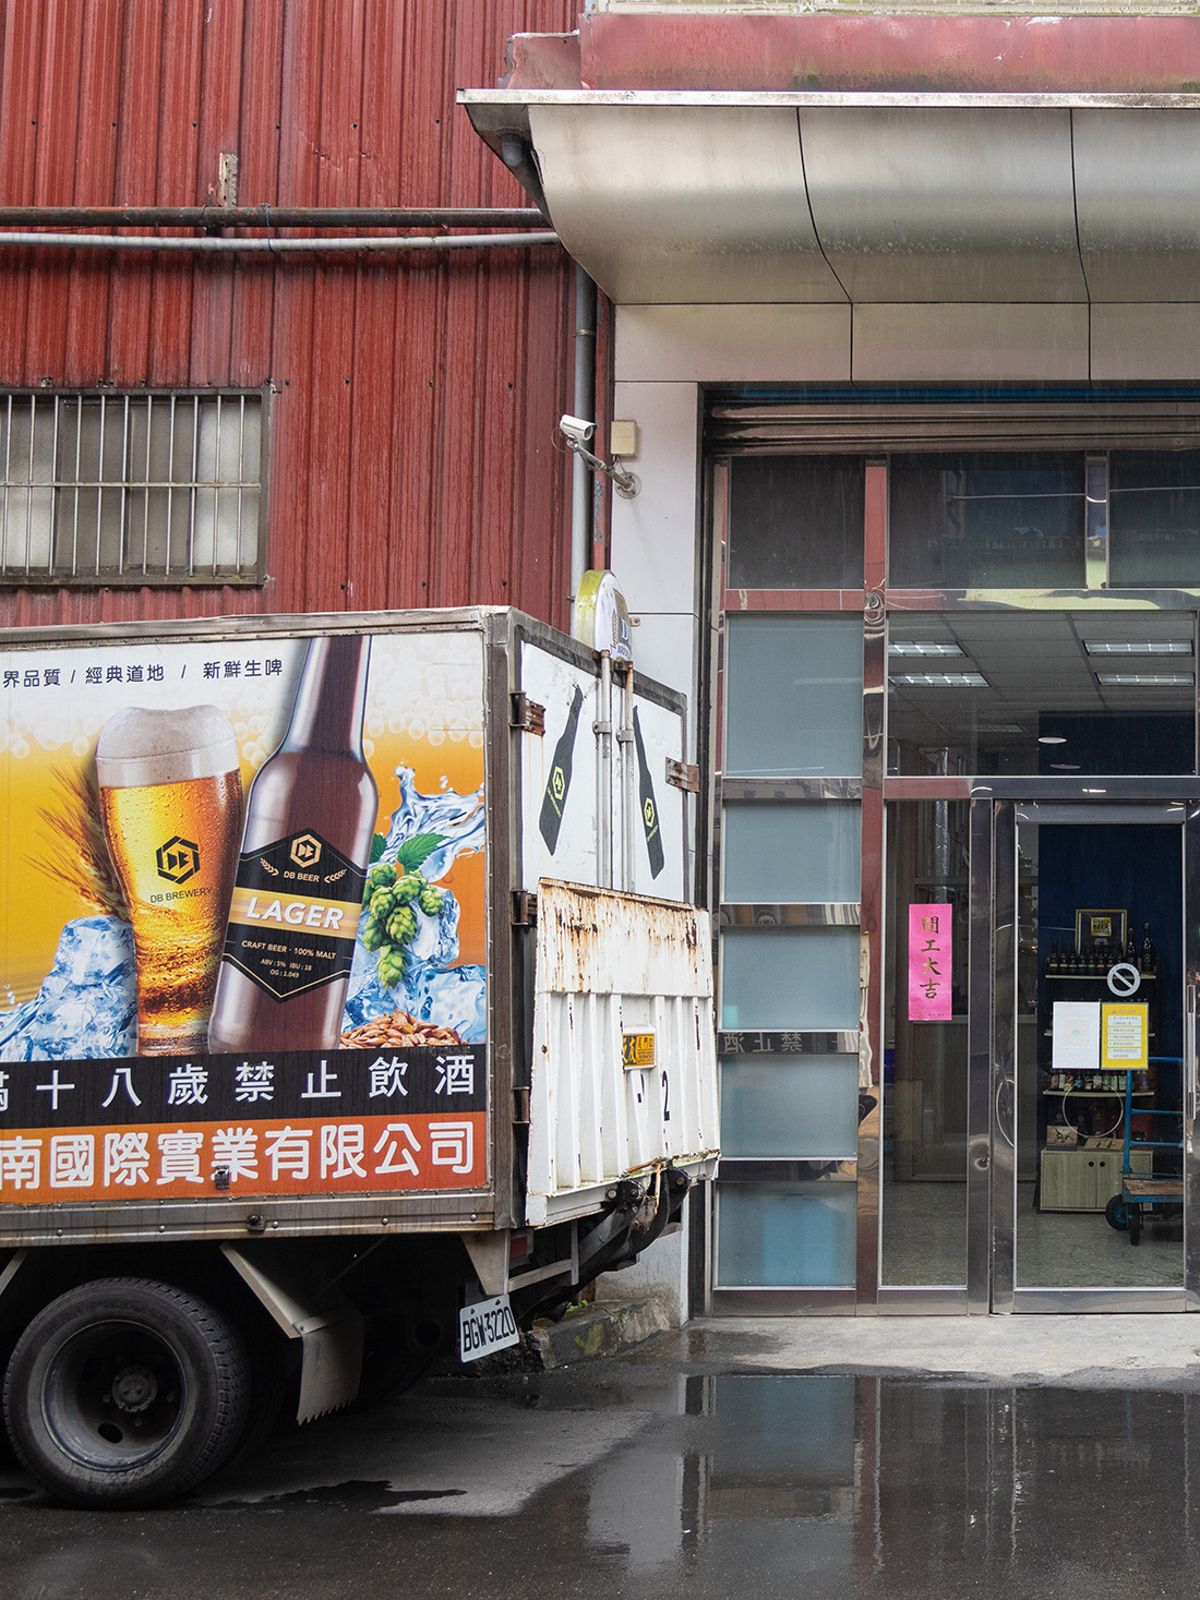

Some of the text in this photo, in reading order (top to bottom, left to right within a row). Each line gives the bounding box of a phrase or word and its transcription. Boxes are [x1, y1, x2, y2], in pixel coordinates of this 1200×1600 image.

[3, 668, 61, 689] 界品質
[85, 664, 165, 685] 經典道地
[203, 658, 283, 680] 新鮮生啤
[283, 871, 320, 882] DB BEER
[150, 887, 212, 903] DB BREWERY
[246, 896, 344, 930] LAGER
[241, 940, 337, 960] CRAFT BEER 100% MALT
[0, 1121, 474, 1190] 南國際實業有限公司
[462, 1306, 516, 1353] BGW-3220
